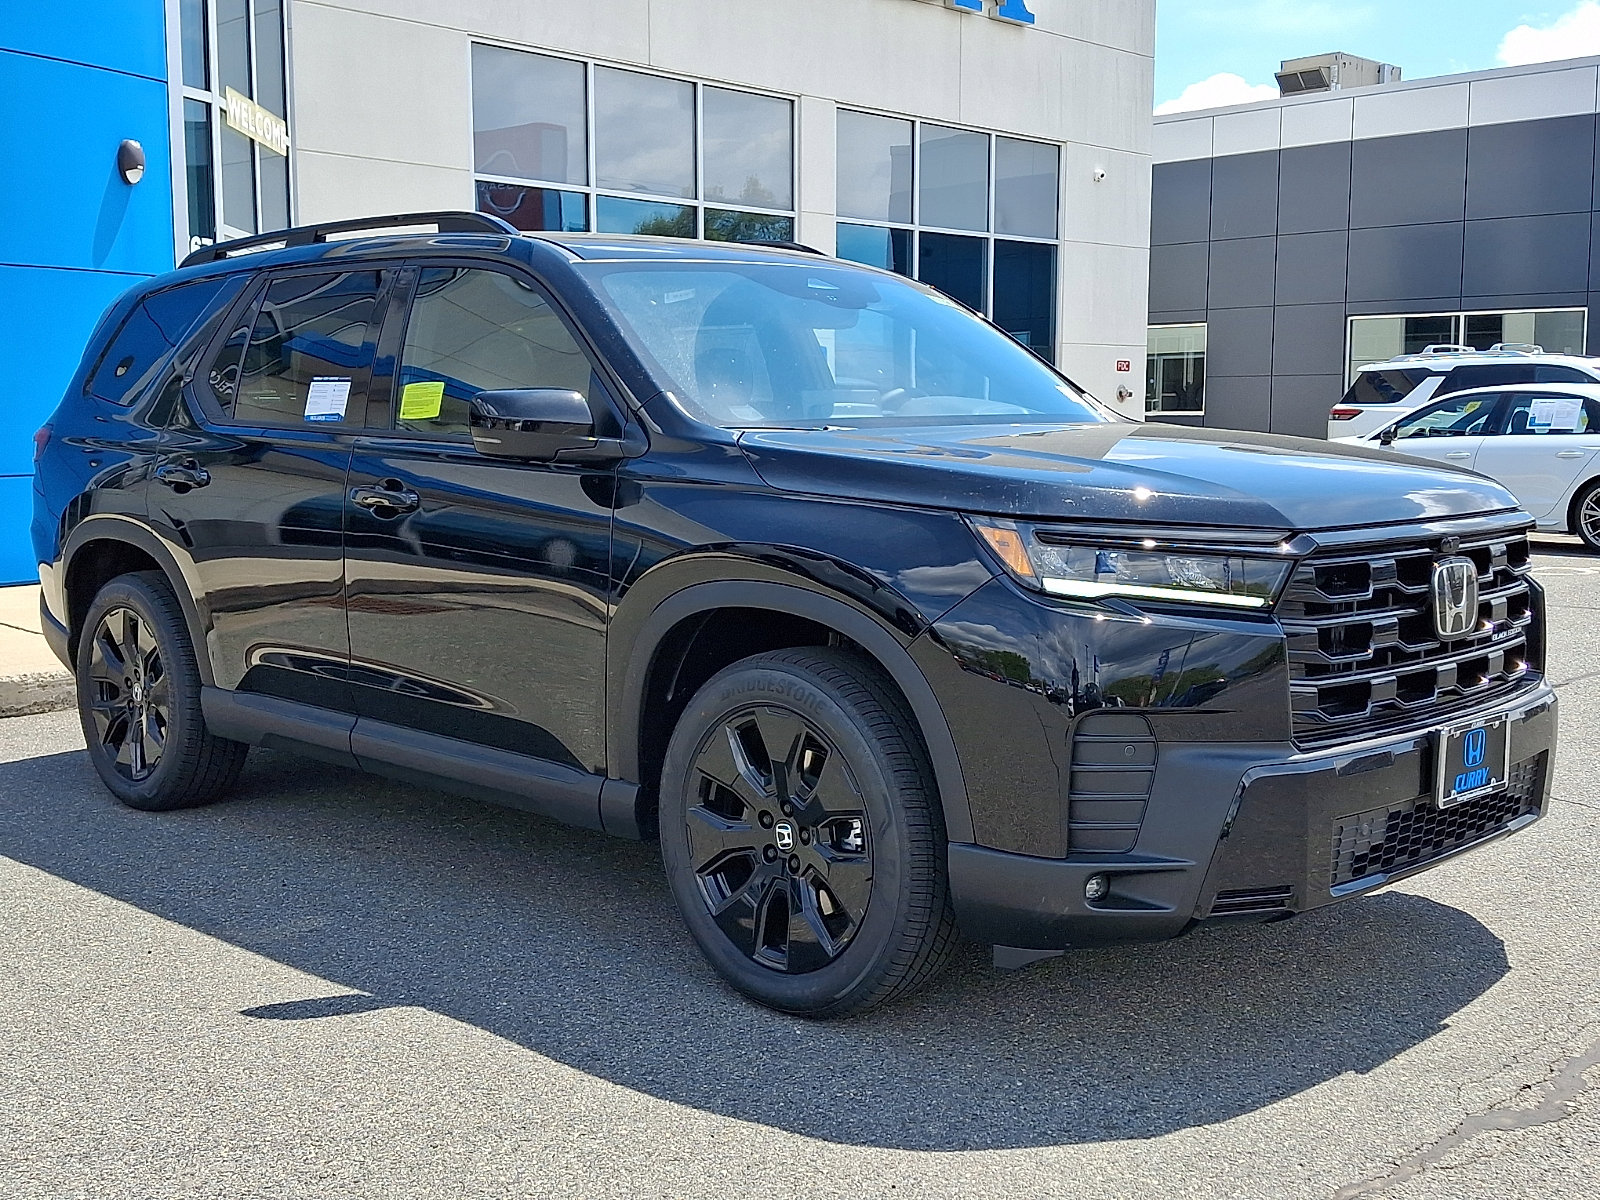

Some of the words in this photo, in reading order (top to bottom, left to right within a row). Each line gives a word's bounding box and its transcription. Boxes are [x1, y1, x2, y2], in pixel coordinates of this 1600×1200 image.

[227, 94, 287, 150] WELCOME
[1117, 361, 1129, 370] FDC
[1454, 766, 1490, 793] CURRY
